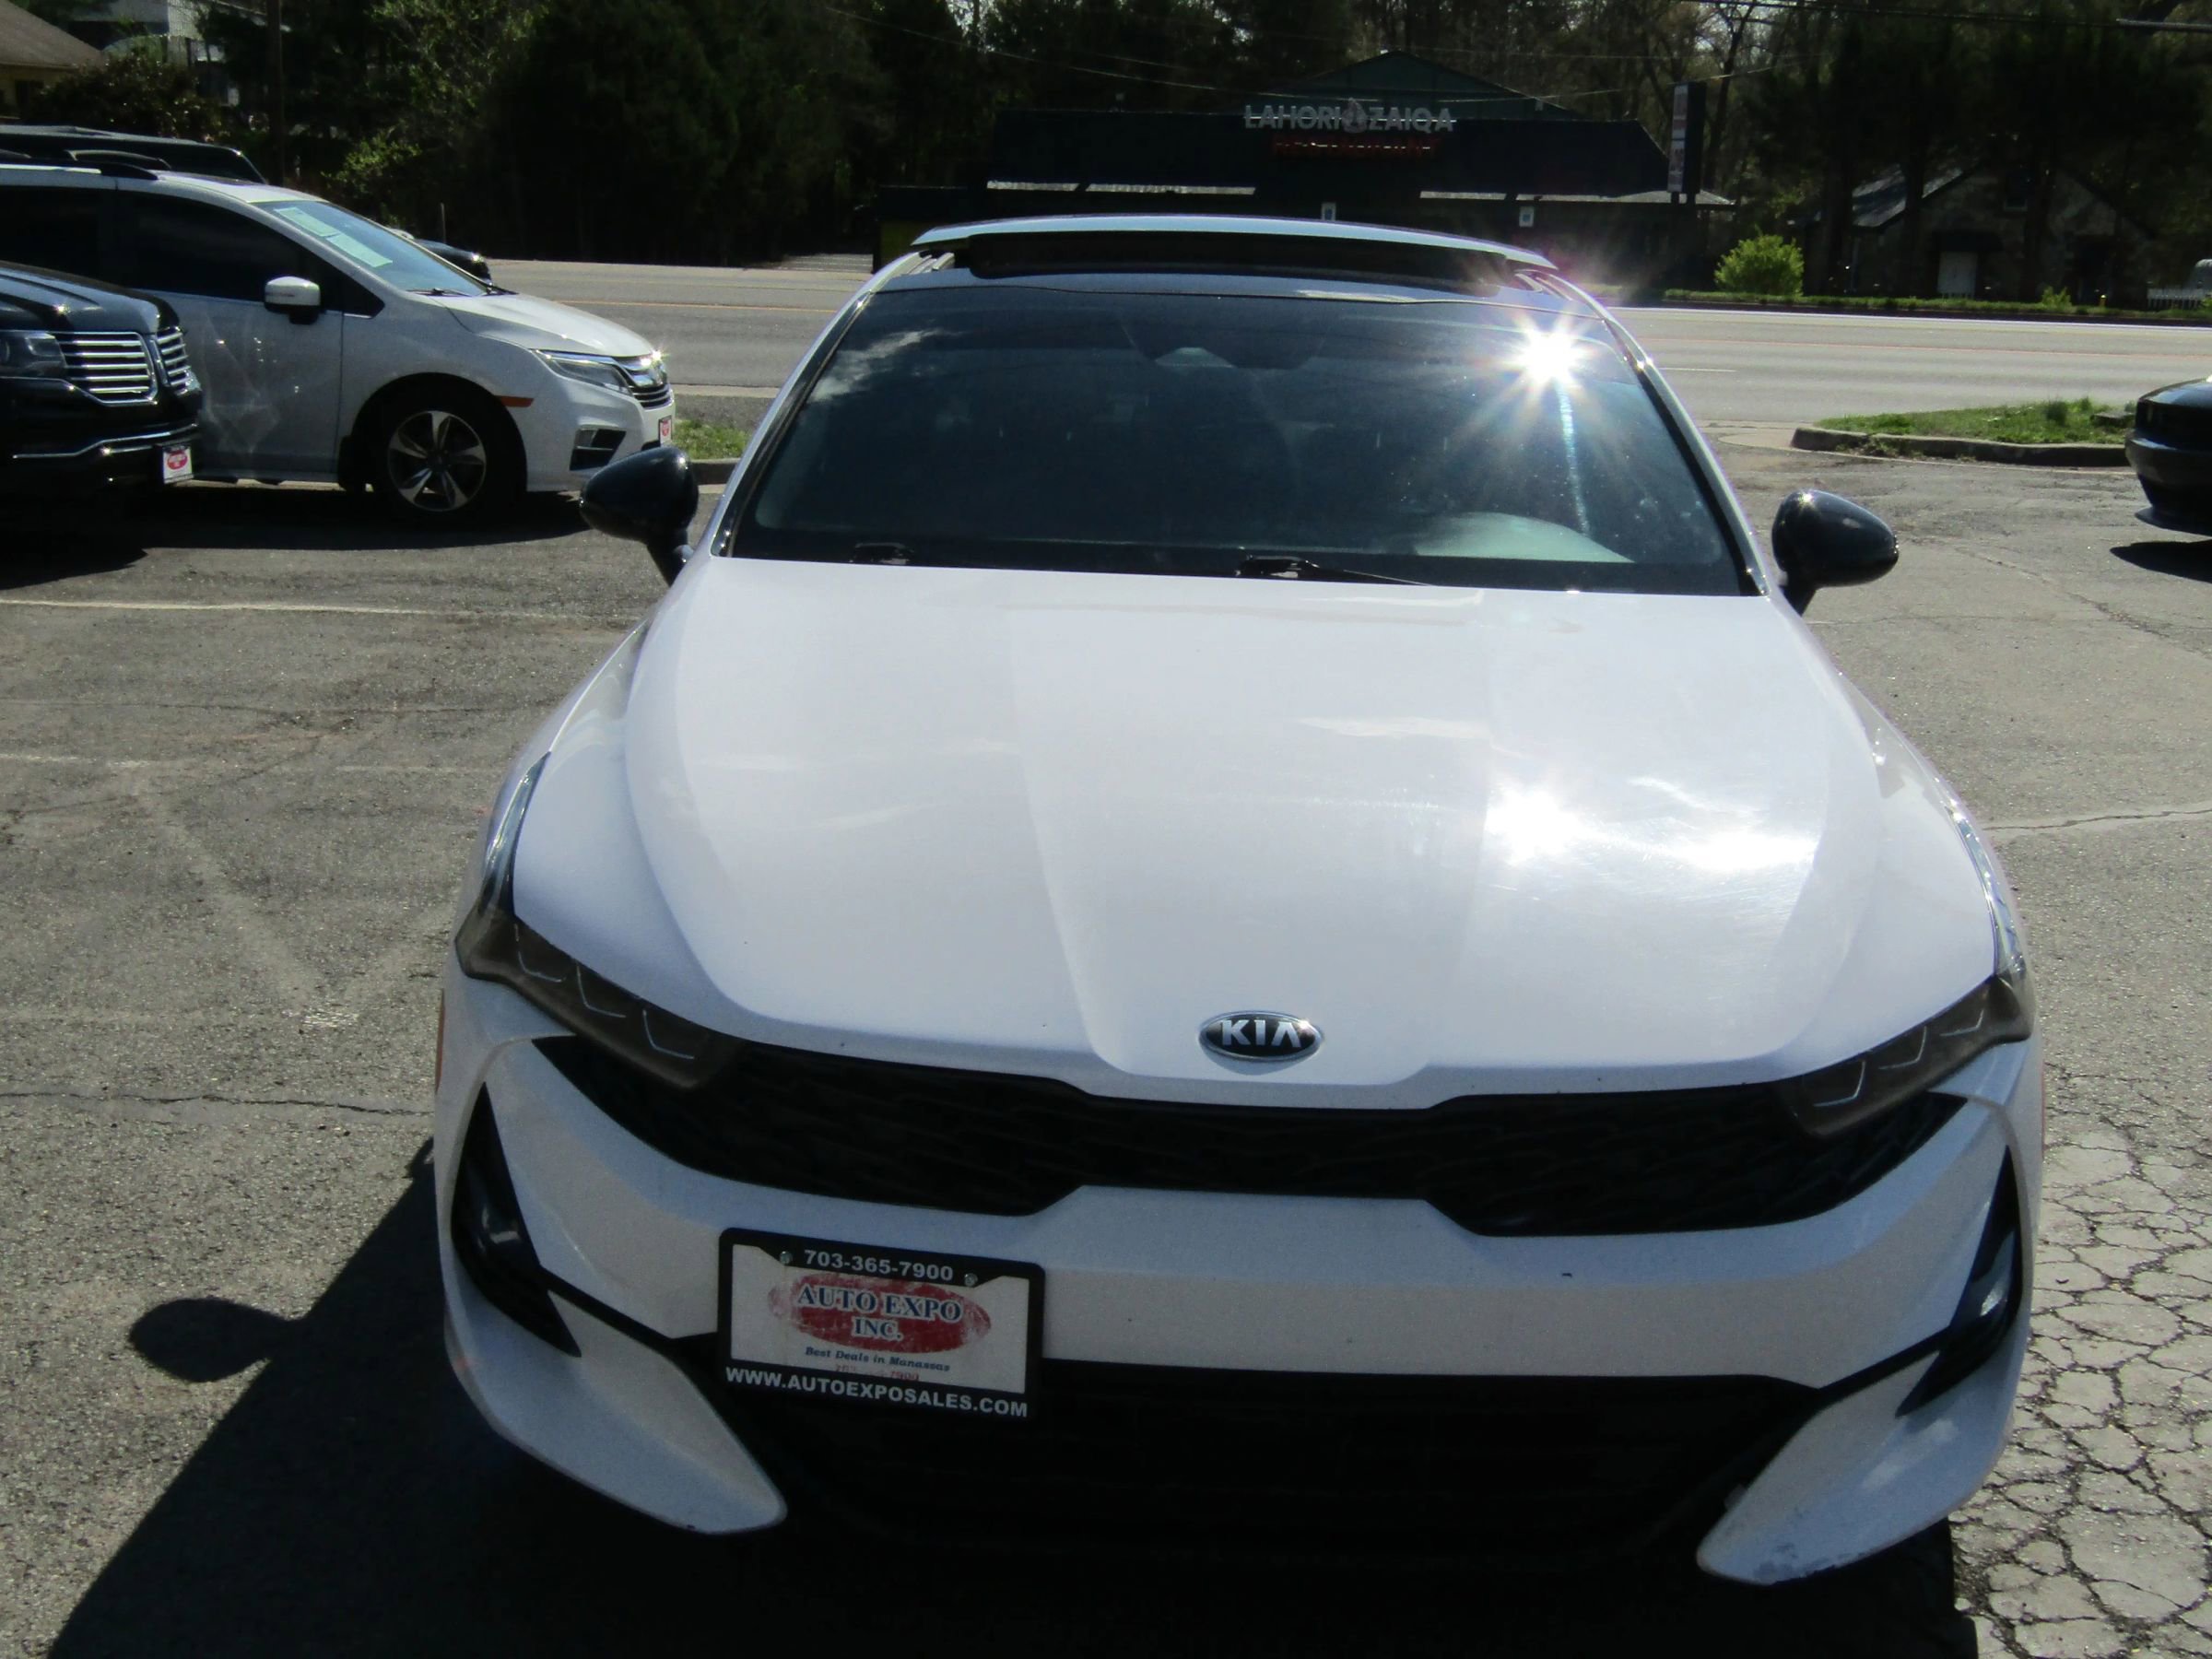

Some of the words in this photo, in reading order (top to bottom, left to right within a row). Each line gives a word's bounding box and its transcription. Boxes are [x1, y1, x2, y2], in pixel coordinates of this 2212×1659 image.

[1243, 104, 1341, 131] LAHORI
[1369, 106, 1454, 134] ZAIQA
[1218, 1018, 1301, 1048] KIA
[804, 1249, 954, 1282] 703-365-7900
[796, 1285, 877, 1313] AUTO
[884, 1293, 963, 1322] EXPO
[854, 1317, 903, 1340] INC.
[805, 1346, 831, 1358] Best
[835, 1350, 869, 1362] Deals
[873, 1355, 886, 1365] in
[888, 1356, 951, 1372] Manassas
[725, 1366, 1029, 1418] WWW.AUTOEXPOSALES.COM
